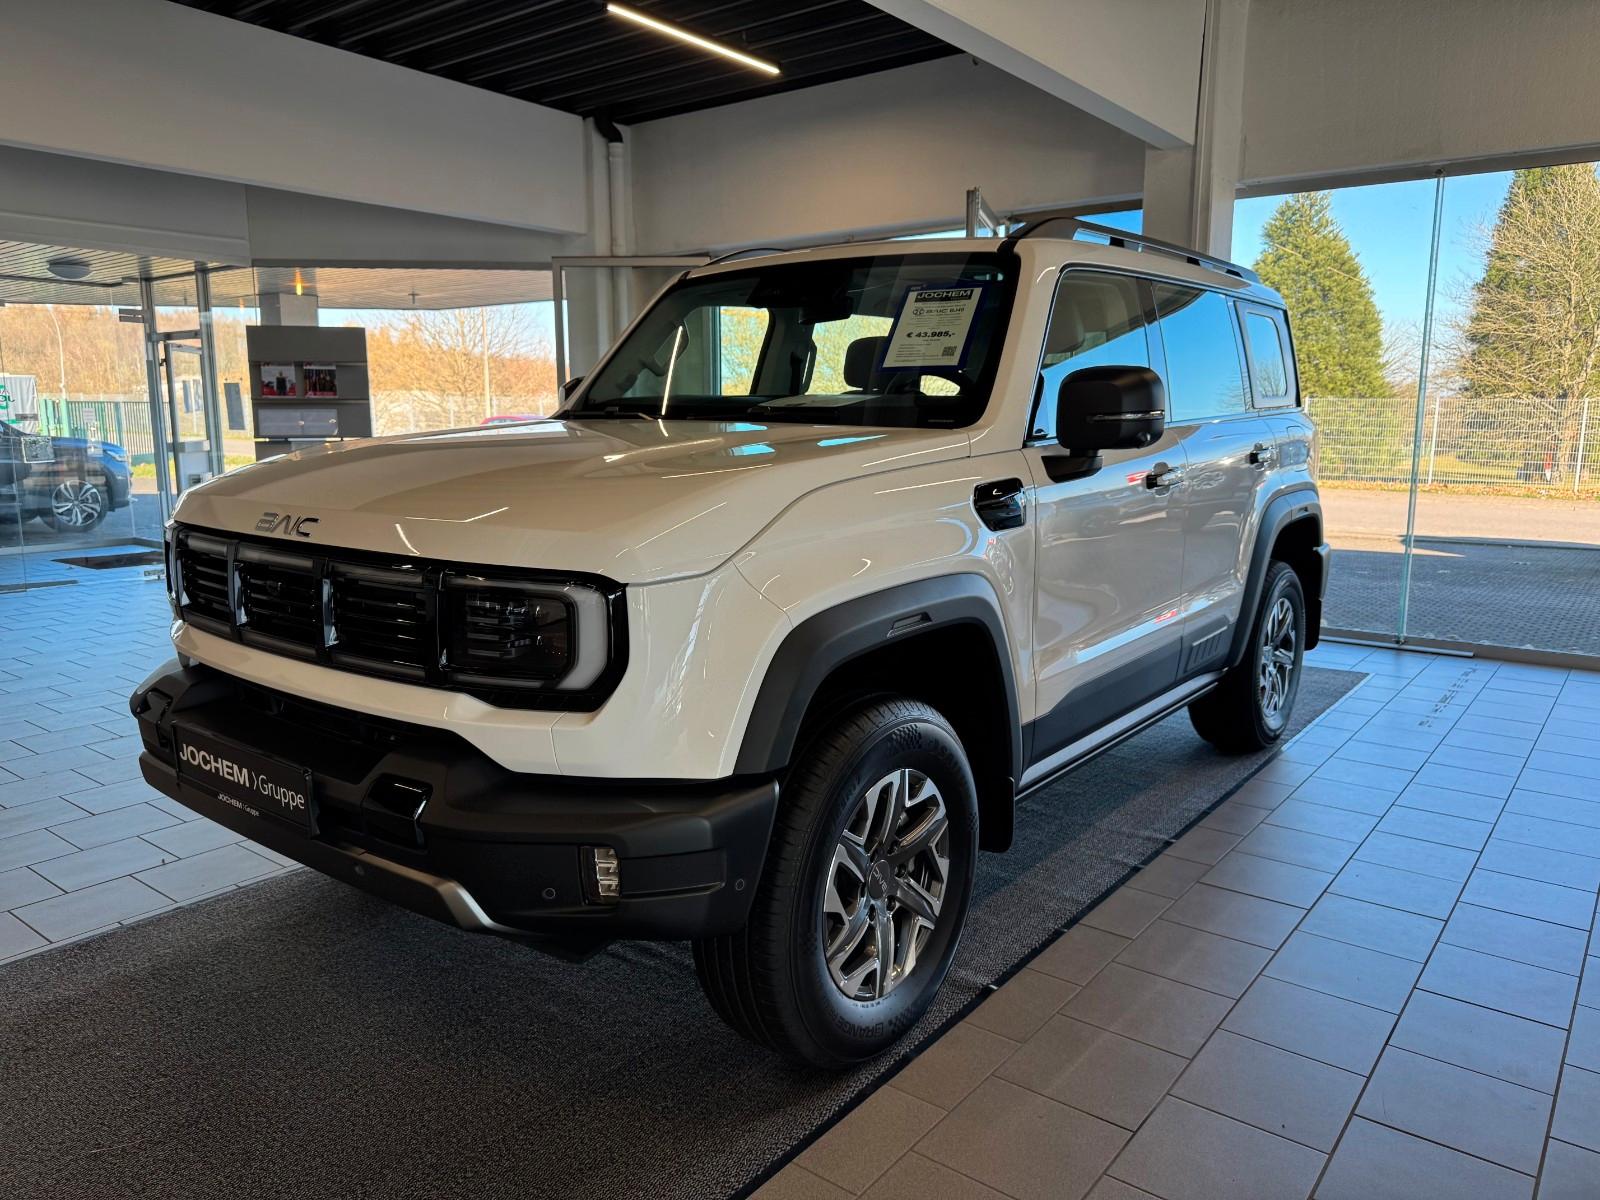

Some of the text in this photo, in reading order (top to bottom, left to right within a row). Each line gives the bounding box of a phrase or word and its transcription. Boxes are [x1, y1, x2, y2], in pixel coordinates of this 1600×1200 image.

[918, 290, 971, 298] JOCHEM
[255, 512, 319, 537] BAIC
[180, 743, 304, 810] JOCHEM Gruppe
[218, 794, 242, 809] JOCHEM
